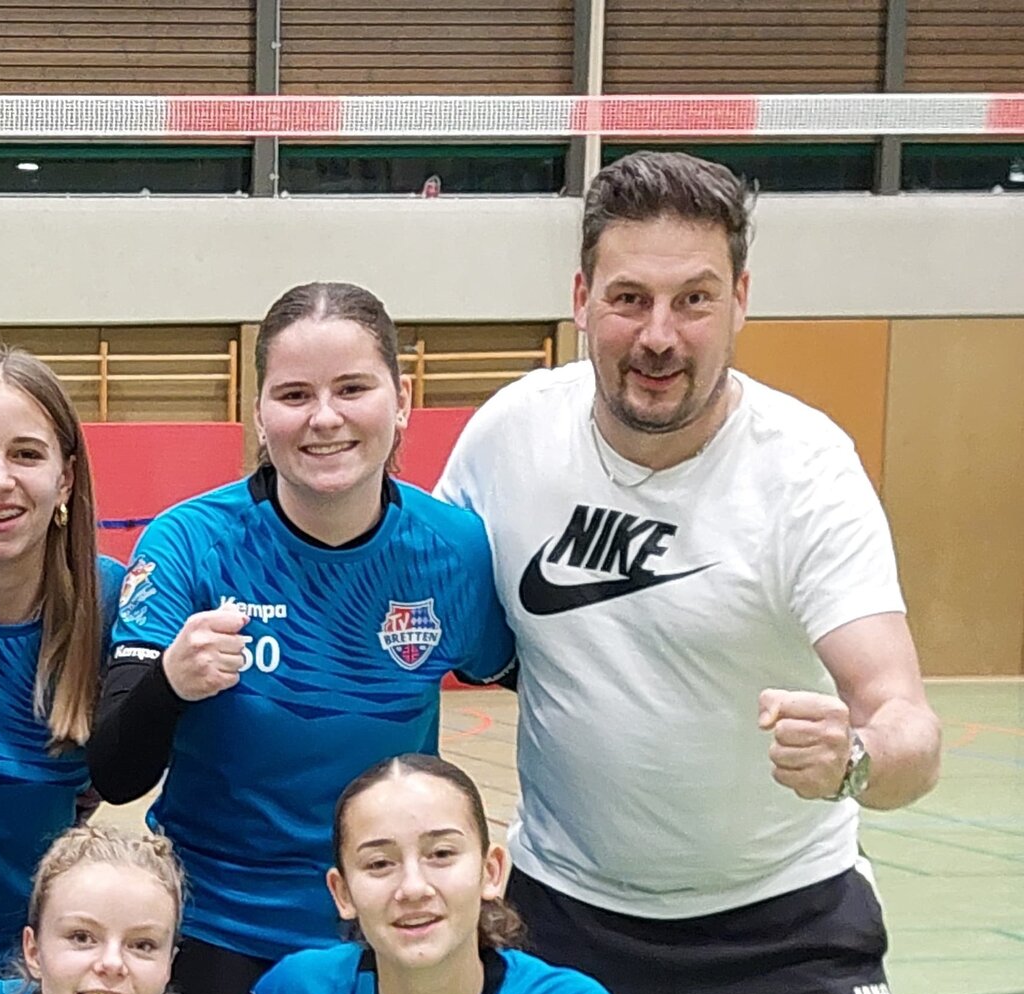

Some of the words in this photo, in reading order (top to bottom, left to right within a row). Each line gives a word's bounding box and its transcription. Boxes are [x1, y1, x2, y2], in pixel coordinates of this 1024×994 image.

[547, 504, 678, 575] NIKE
[388, 612, 411, 632] TV
[383, 631, 438, 645] BRETTEN
